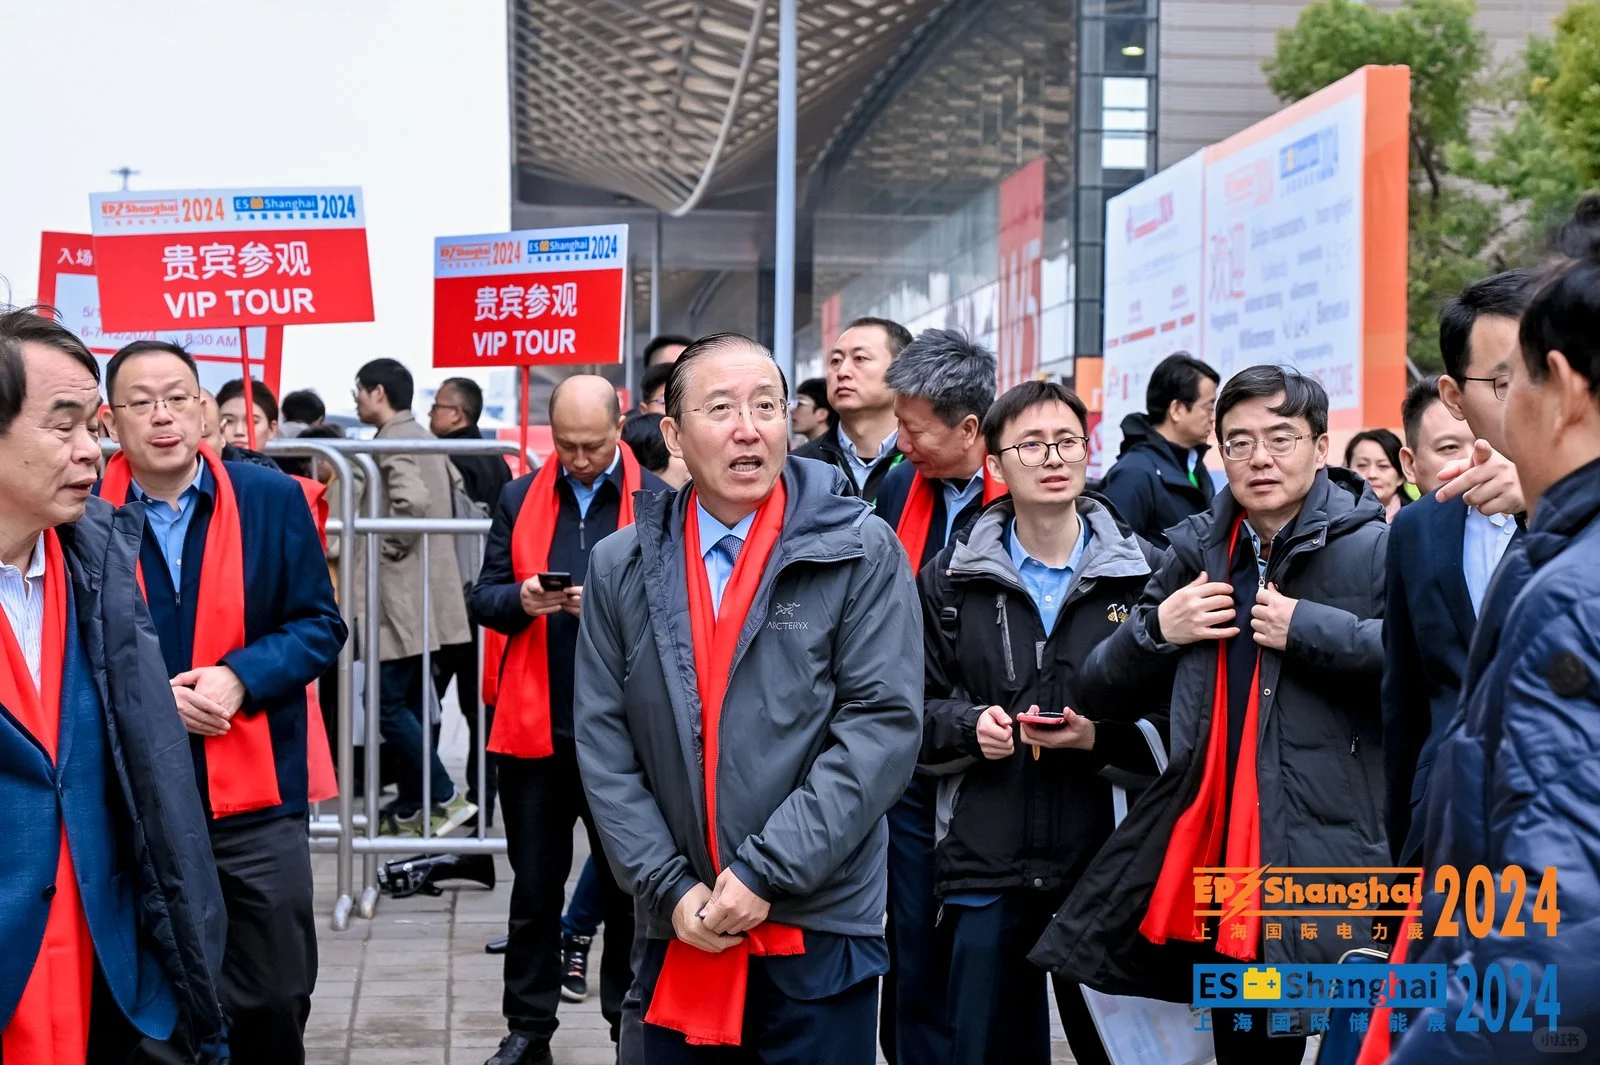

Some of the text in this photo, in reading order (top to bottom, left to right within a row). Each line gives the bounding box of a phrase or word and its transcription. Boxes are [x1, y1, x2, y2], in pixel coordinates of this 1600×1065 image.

[126, 203, 178, 216] Shanghai
[182, 198, 224, 222] 2024
[235, 199, 249, 209] ES
[264, 197, 315, 210] Shanghai
[320, 195, 356, 219] 2024
[57, 248, 93, 266] 入场
[493, 241, 521, 265] 2024
[549, 238, 588, 252] Shanghai
[591, 235, 617, 259] 2024
[162, 240, 312, 282] 贵宾参观
[164, 288, 316, 319] VIP TOUR
[474, 282, 578, 322] 贵宾参观
[81, 325, 157, 341] 6-712/2024
[215, 335, 237, 347] AM
[472, 328, 576, 357] VIP TOUR
